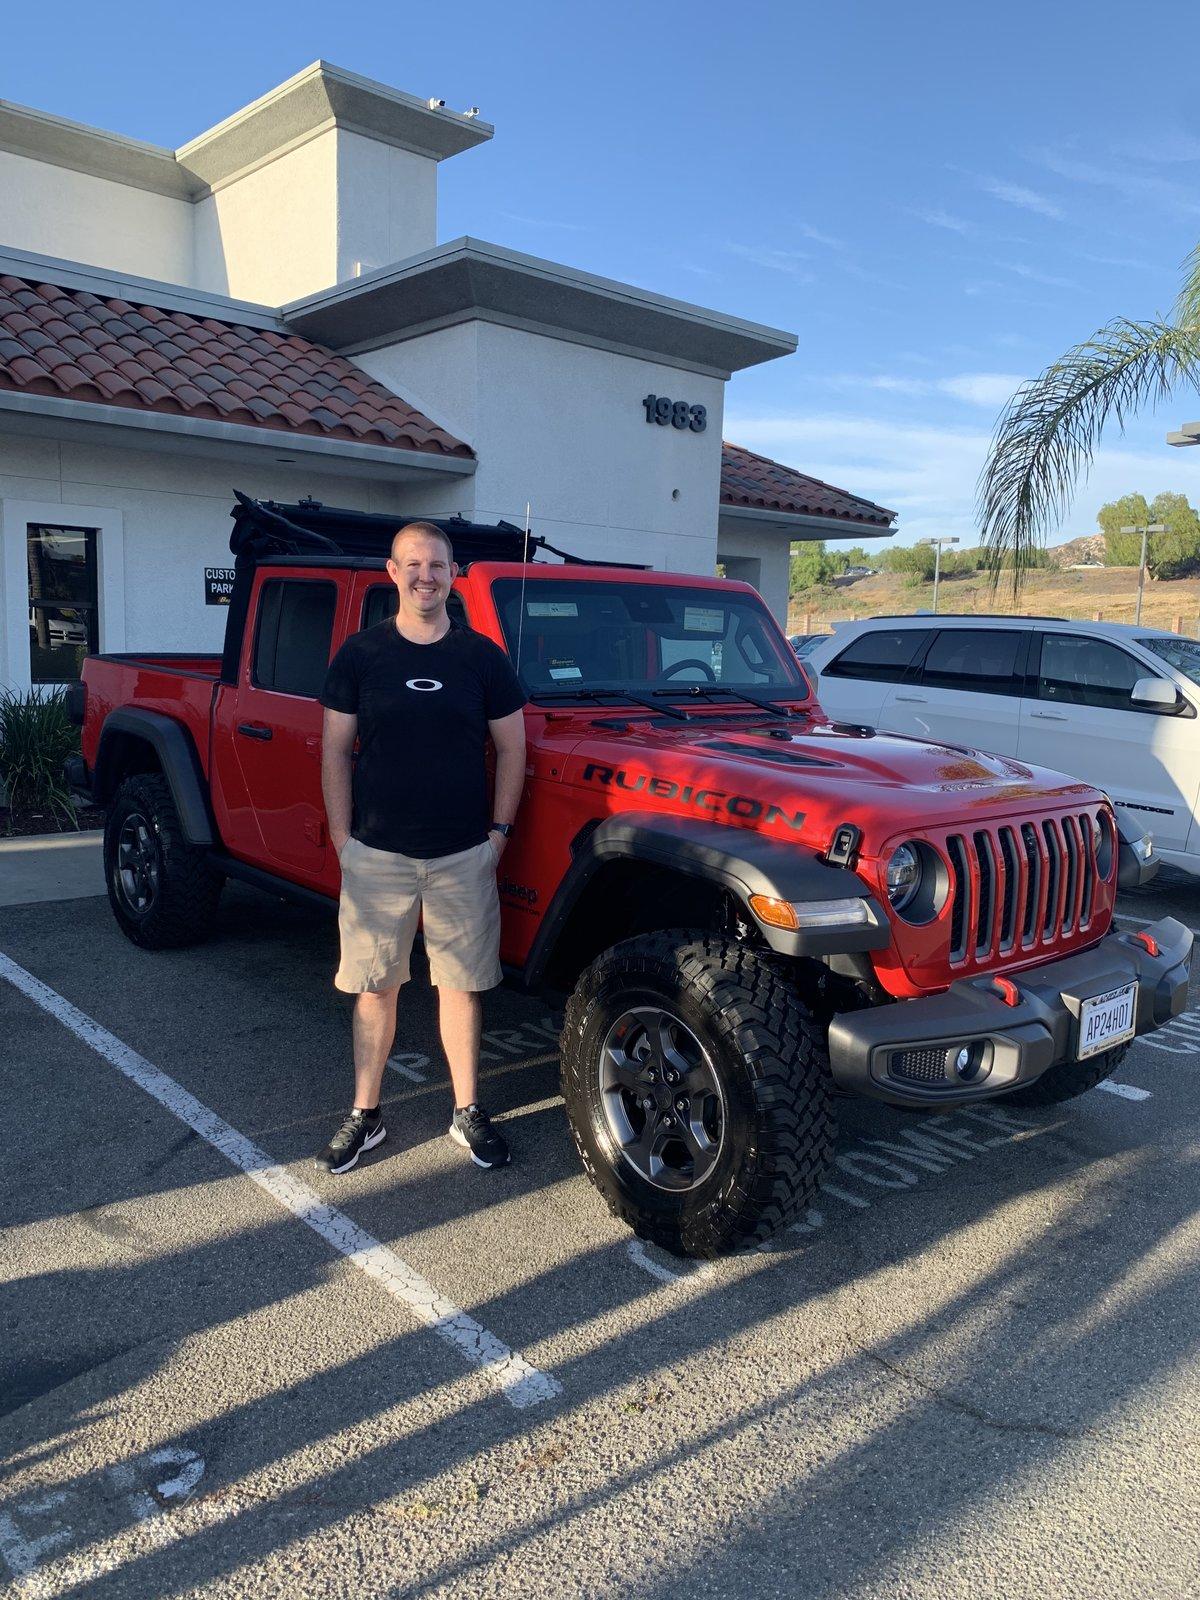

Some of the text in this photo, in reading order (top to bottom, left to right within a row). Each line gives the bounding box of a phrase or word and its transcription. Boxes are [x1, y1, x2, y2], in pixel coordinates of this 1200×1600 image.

[643, 394, 707, 433] 1983
[205, 569, 236, 580] CUSTO
[582, 763, 806, 831] RUBICON
[1086, 1002, 1129, 1042] AP24H01
